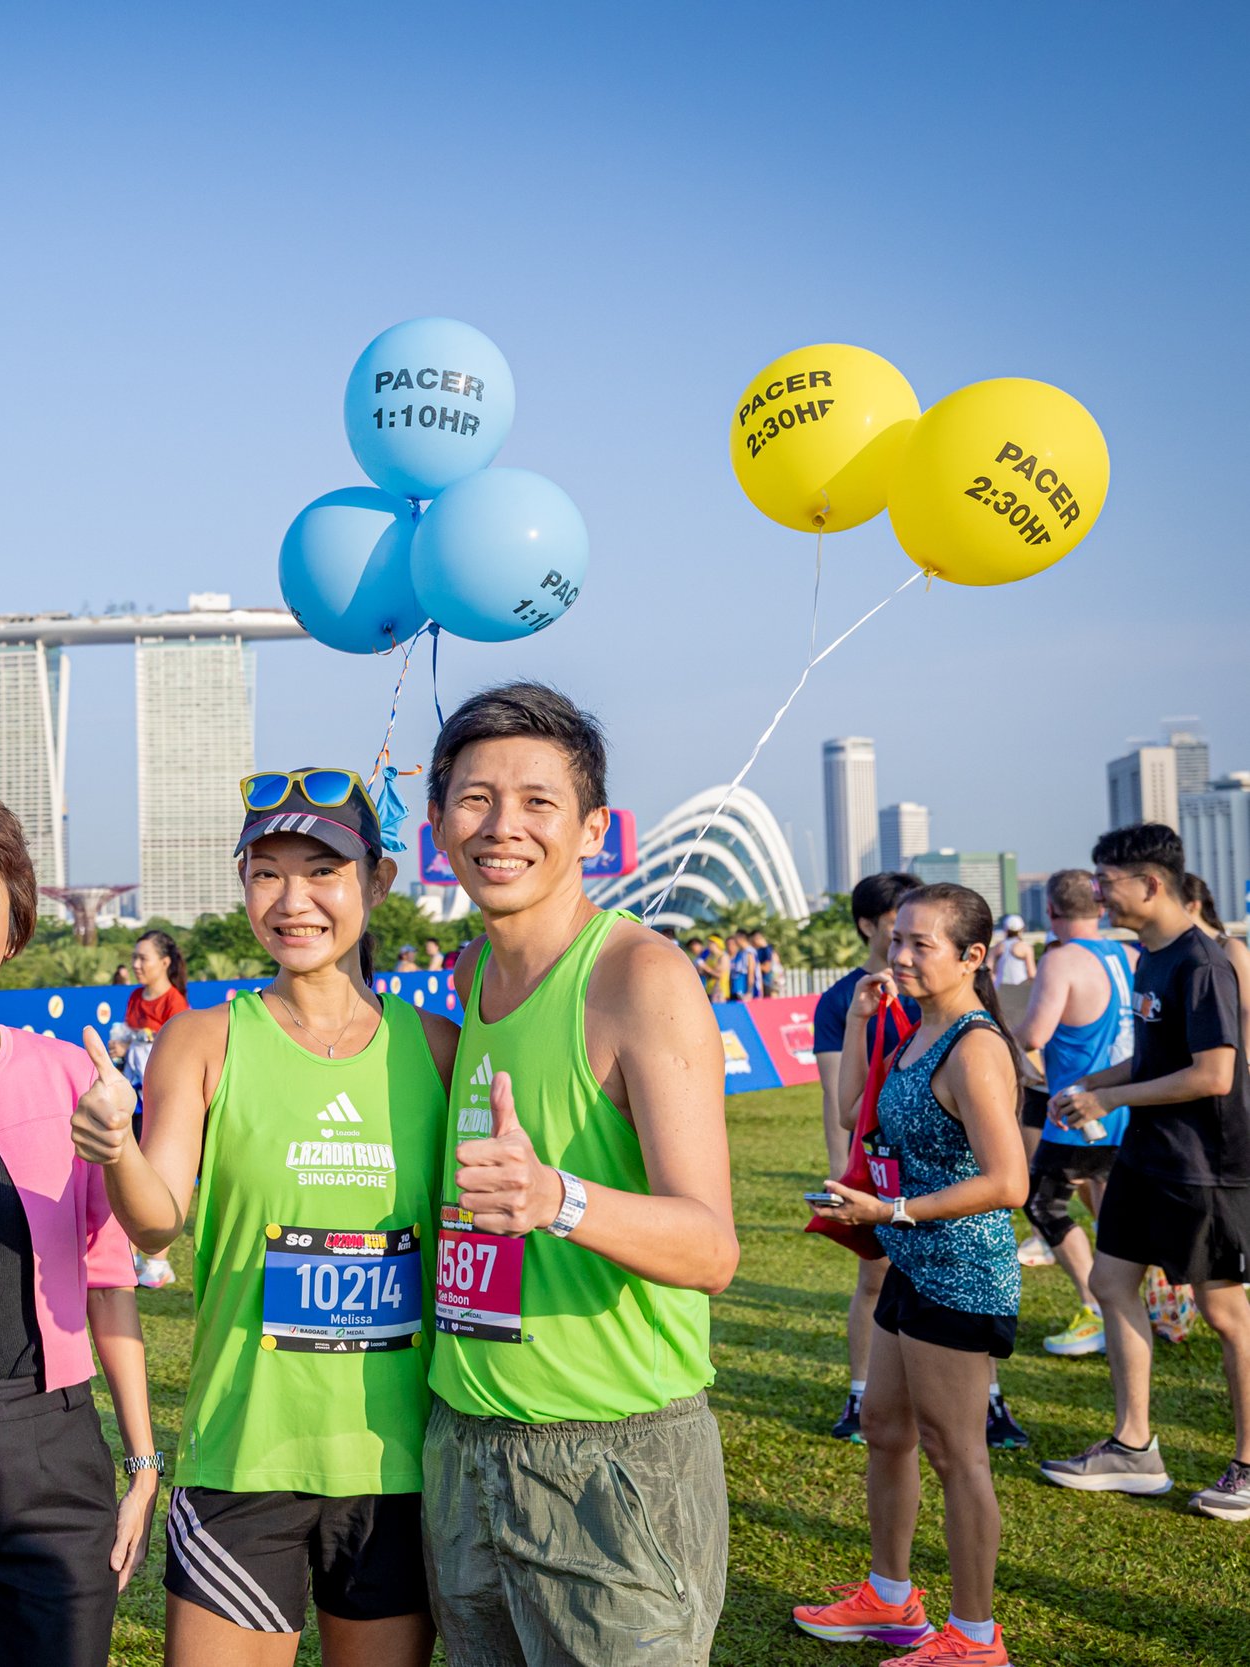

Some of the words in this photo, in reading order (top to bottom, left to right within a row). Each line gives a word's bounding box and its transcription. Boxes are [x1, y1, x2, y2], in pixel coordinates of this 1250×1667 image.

[374, 368, 485, 402] PACER
[739, 371, 832, 427] PACER
[372, 405, 481, 437] 1:10HR
[994, 441, 1080, 530] PACER
[540, 568, 580, 610] PAC
[286, 1141, 354, 1168] LAZADA
[353, 1142, 396, 1170] RUN
[297, 1172, 388, 1188] SINGAPORE
[867, 1160, 888, 1189] 81
[285, 1233, 313, 1247] SG
[400, 1233, 410, 1242] 10
[437, 1239, 498, 1293] 1587
[296, 1263, 402, 1311] 10214
[448, 1292, 469, 1305] Boon
[330, 1313, 373, 1325] Melissa
